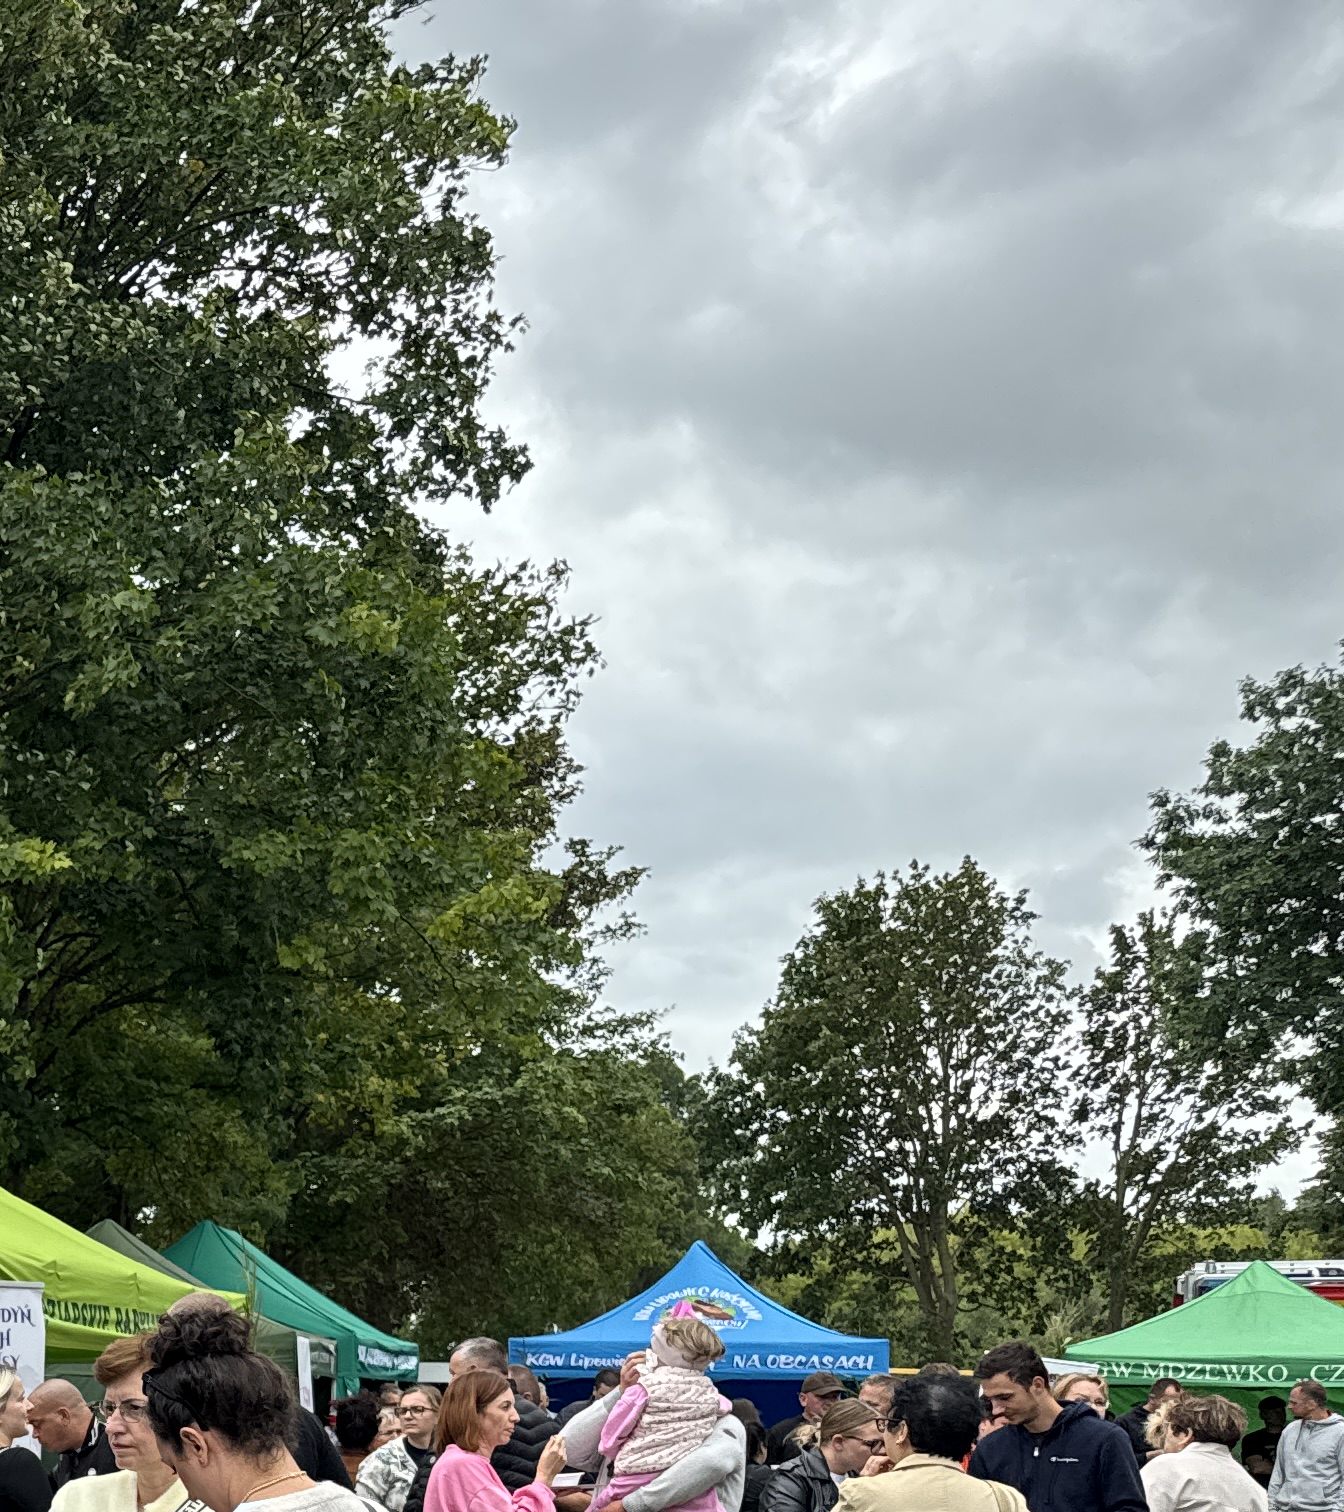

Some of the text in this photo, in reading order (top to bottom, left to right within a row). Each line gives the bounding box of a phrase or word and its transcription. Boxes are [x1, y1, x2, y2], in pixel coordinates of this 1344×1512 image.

[526, 1352, 564, 1366] KGW
[570, 1352, 625, 1369] Lipowie
[733, 1354, 761, 1369] NA
[766, 1354, 874, 1370] OBCASACH
[1093, 1361, 1133, 1378] GW
[1143, 1363, 1288, 1382] MDZEWKO
